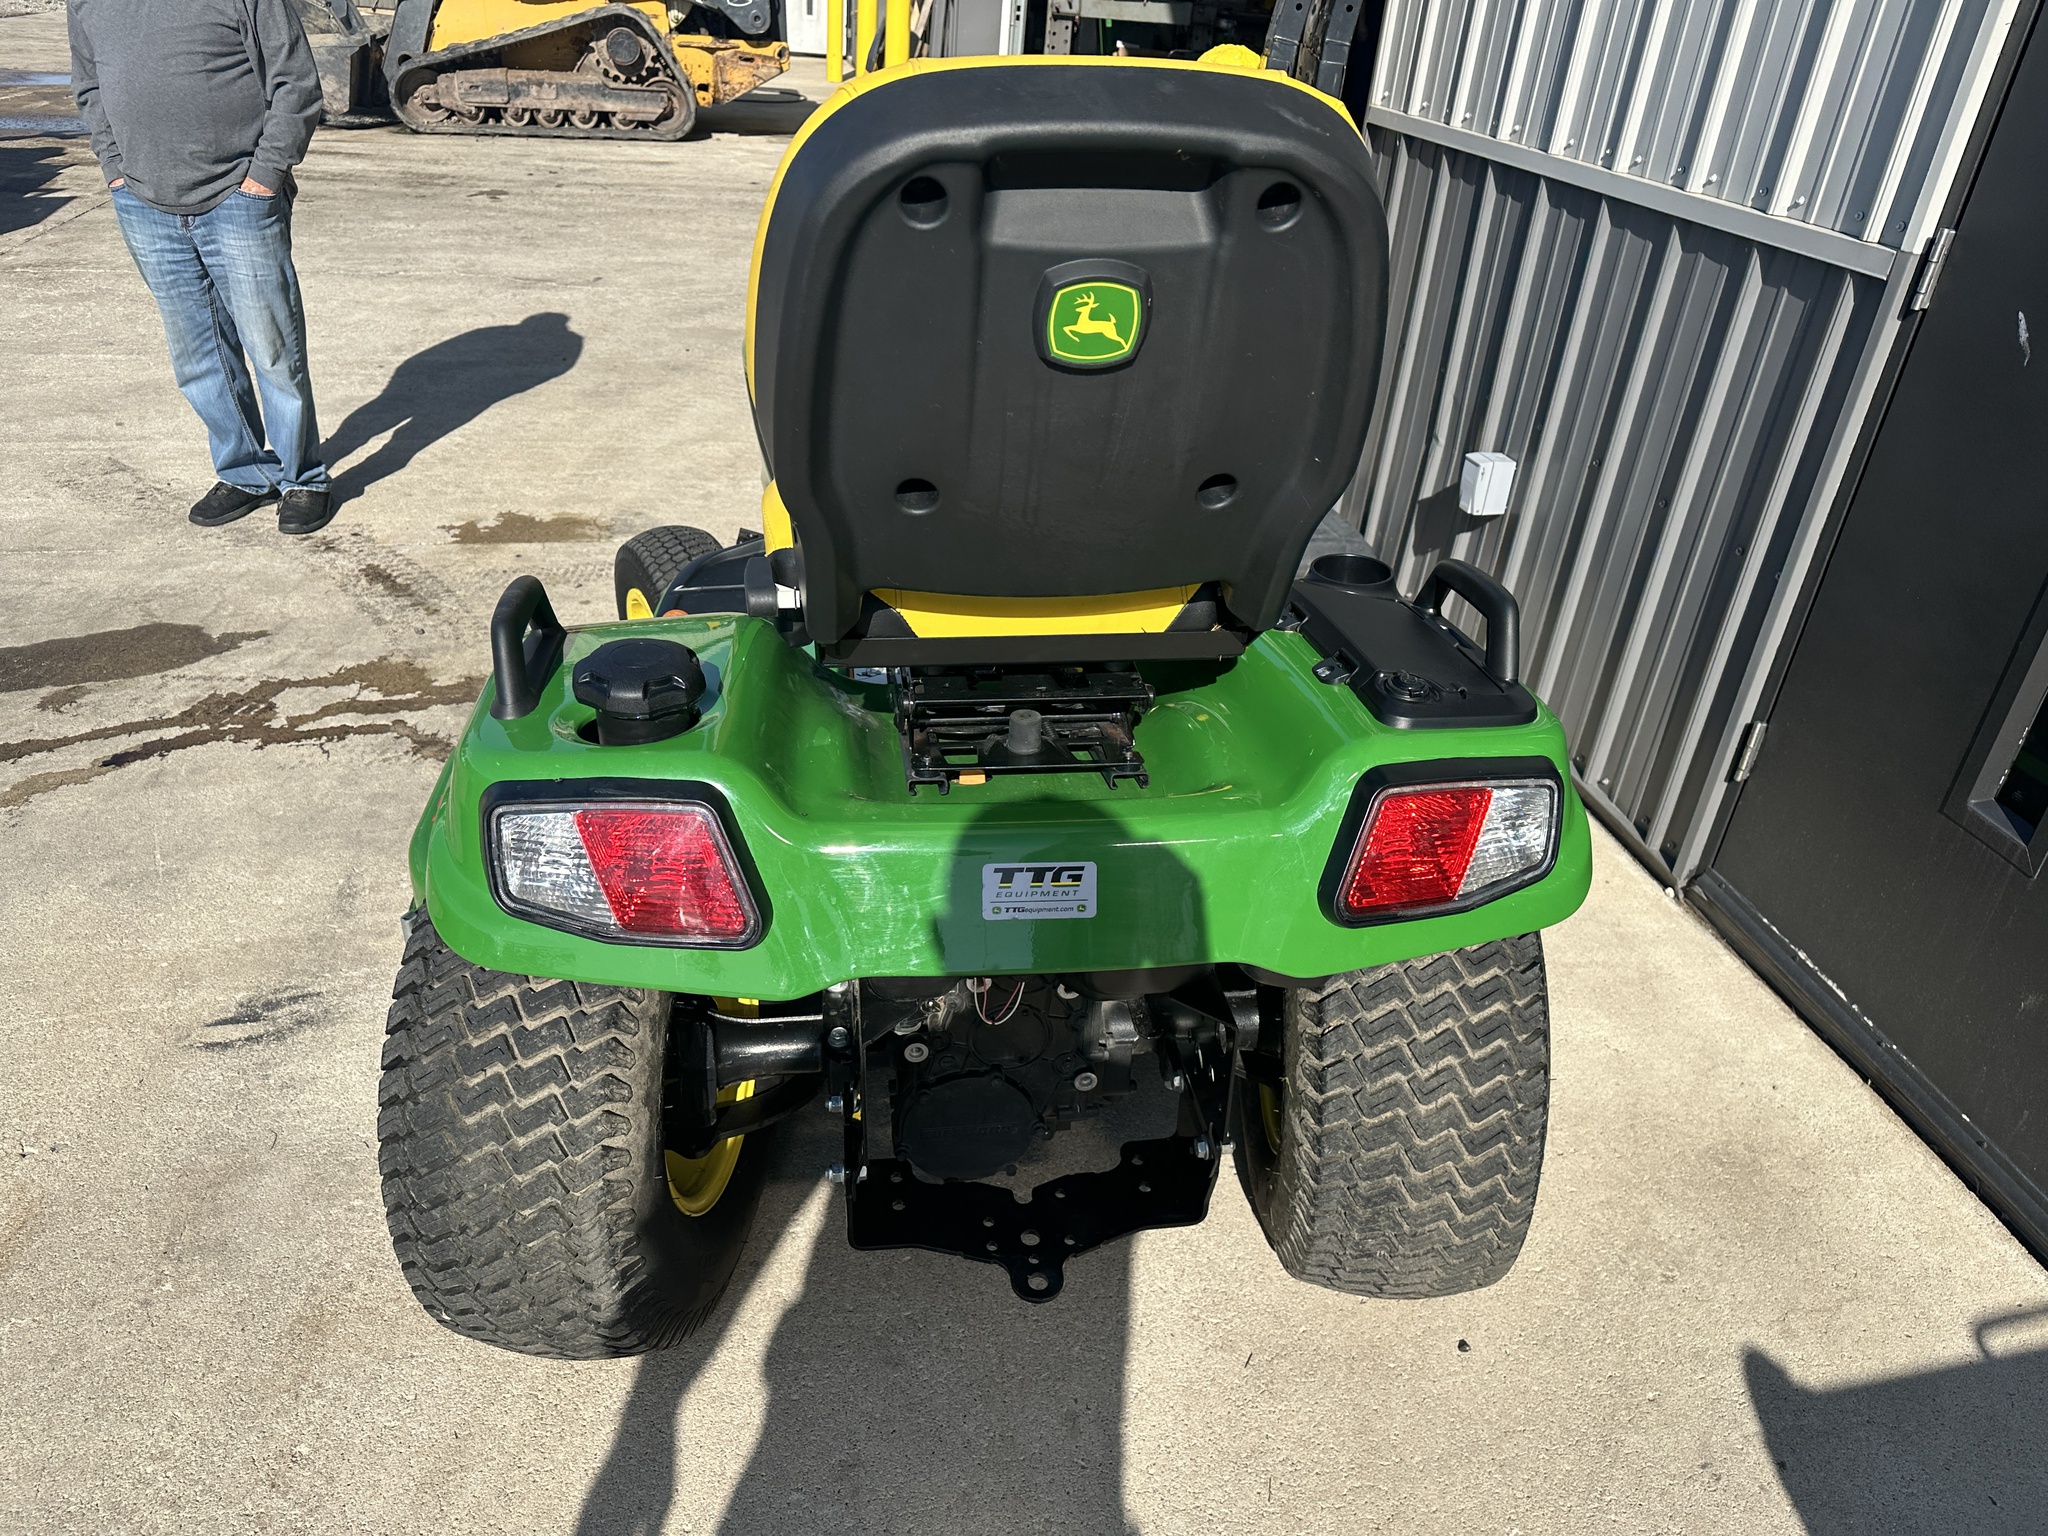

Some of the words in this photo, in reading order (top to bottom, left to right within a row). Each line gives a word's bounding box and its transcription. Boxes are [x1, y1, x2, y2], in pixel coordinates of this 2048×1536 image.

[993, 866, 1085, 888] TTG
[995, 890, 1079, 898] EQUIPMENT
[1004, 905, 1074, 914] TTGequipment.com
